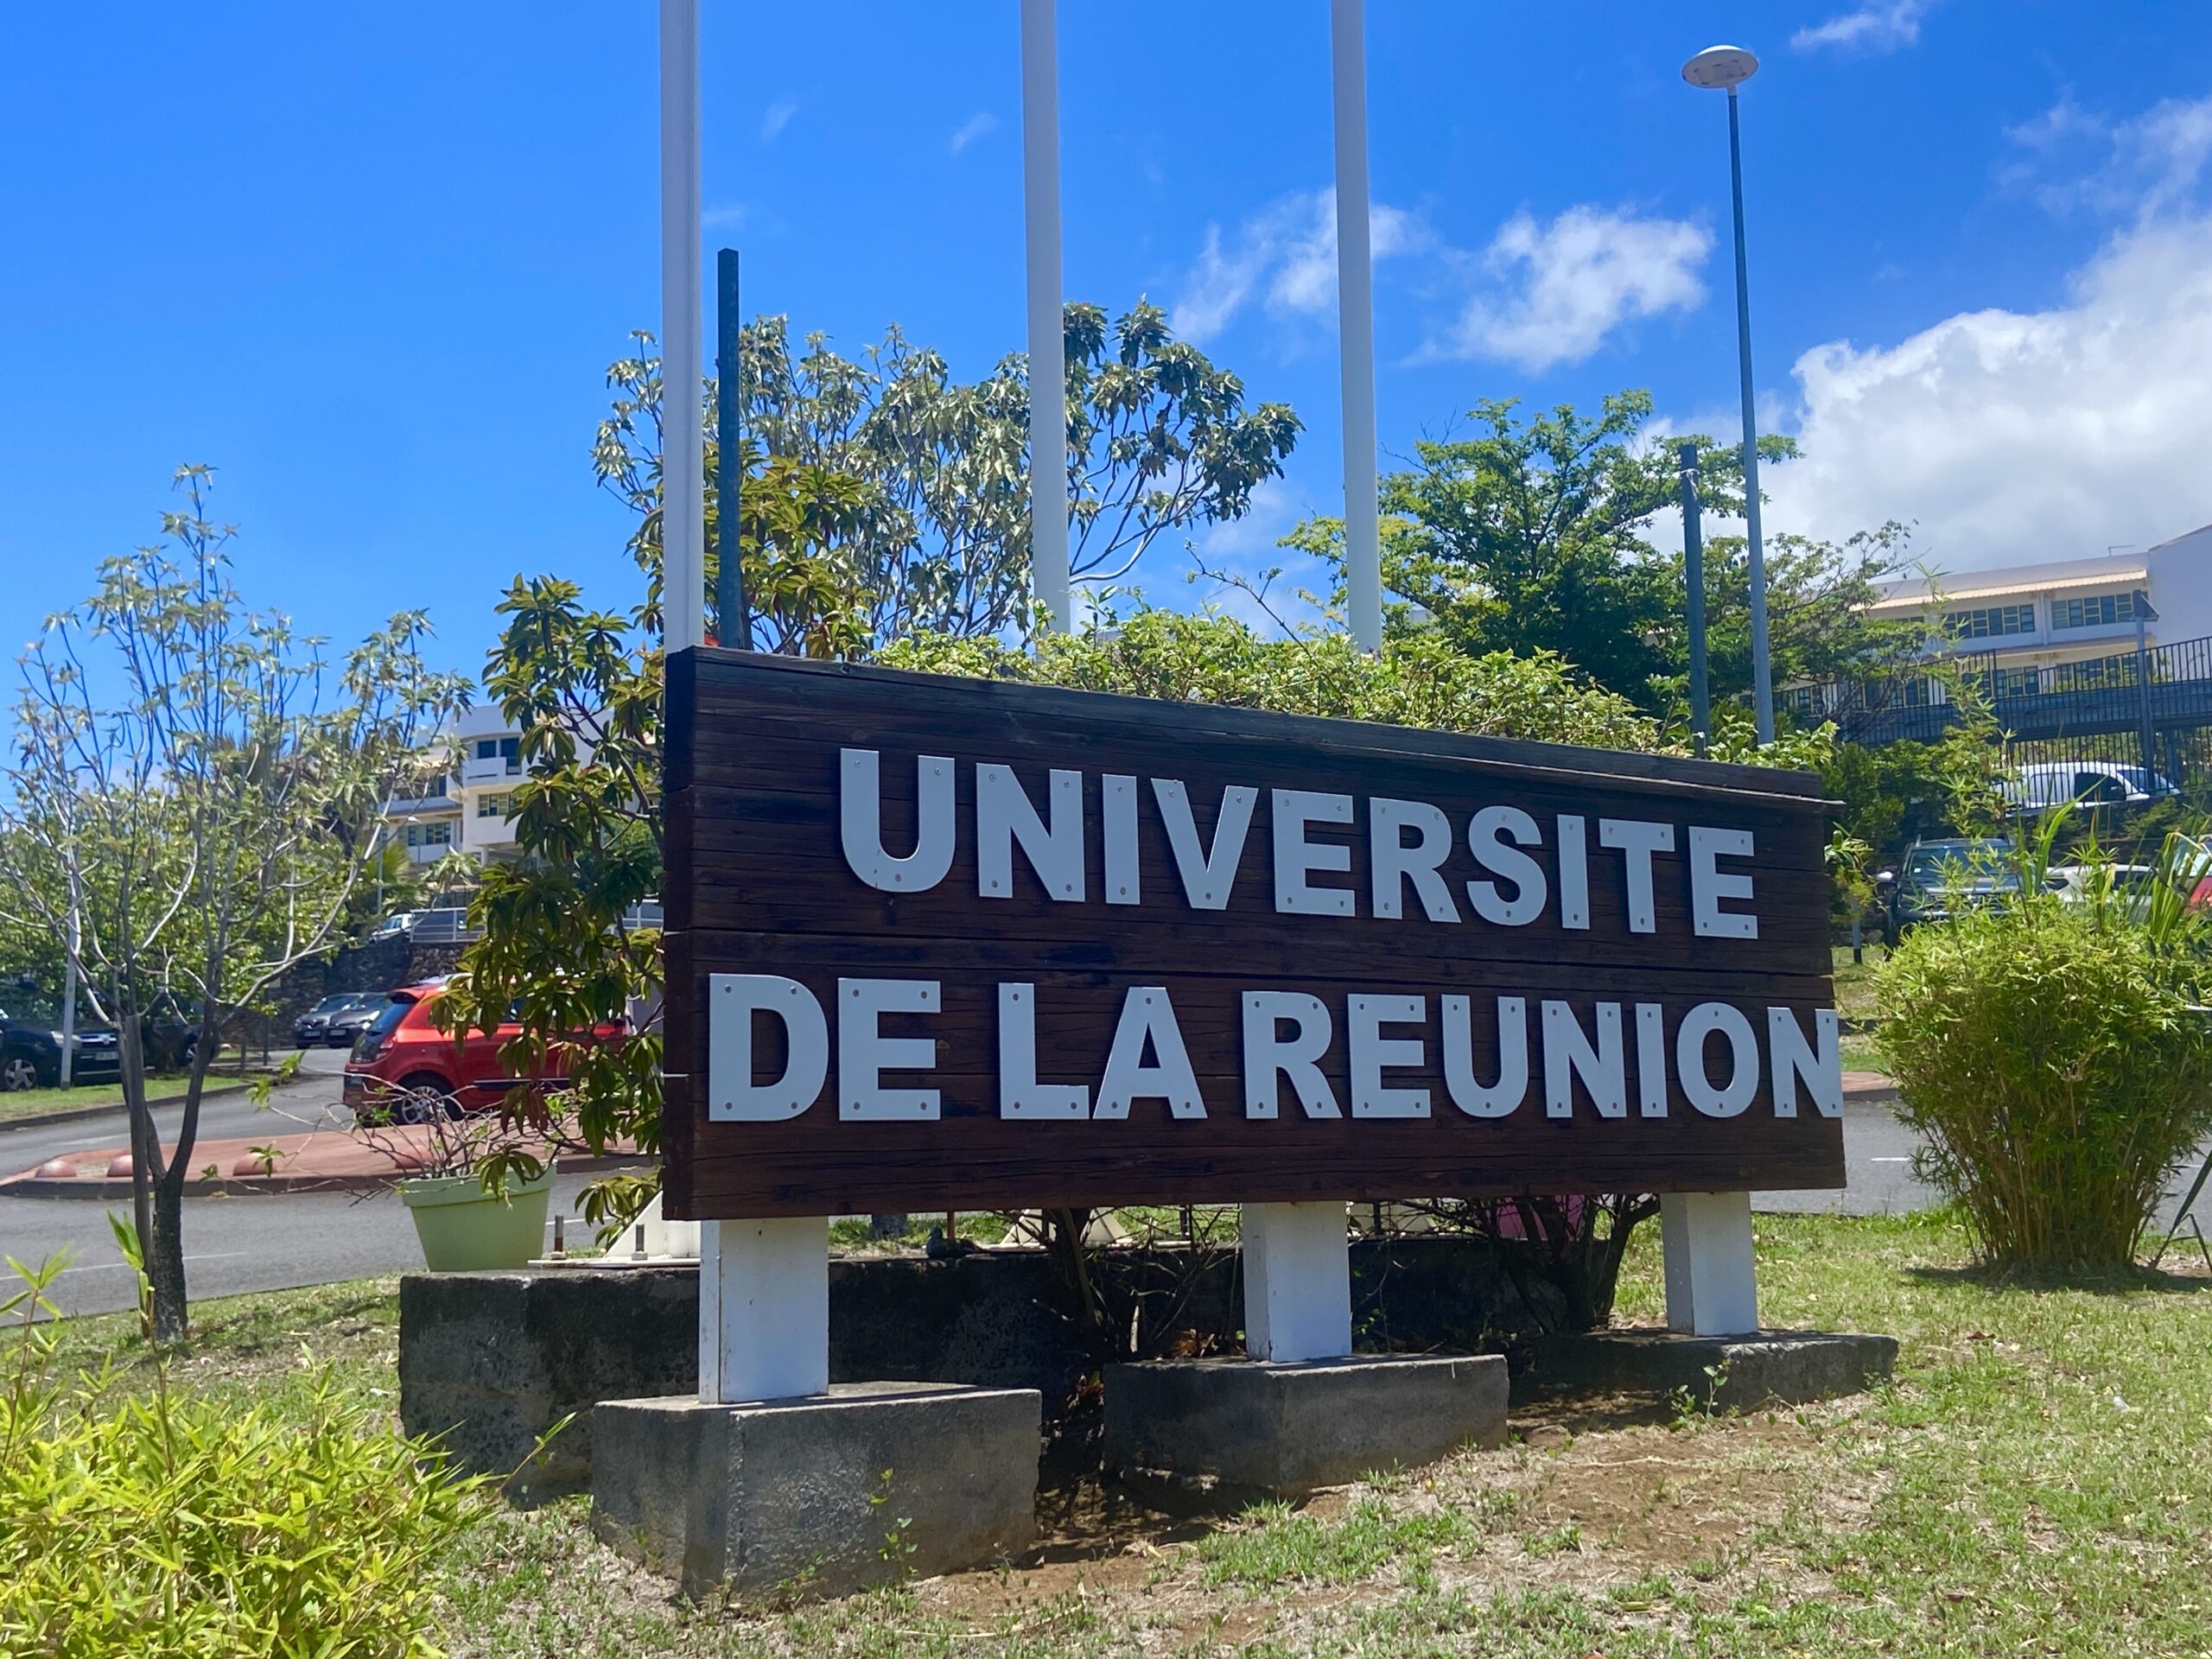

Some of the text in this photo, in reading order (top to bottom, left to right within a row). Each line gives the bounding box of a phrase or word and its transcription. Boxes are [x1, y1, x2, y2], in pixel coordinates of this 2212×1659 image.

[840, 748, 1758, 939] UNIVERSITE
[709, 973, 1844, 1122] DE LA REUNION
